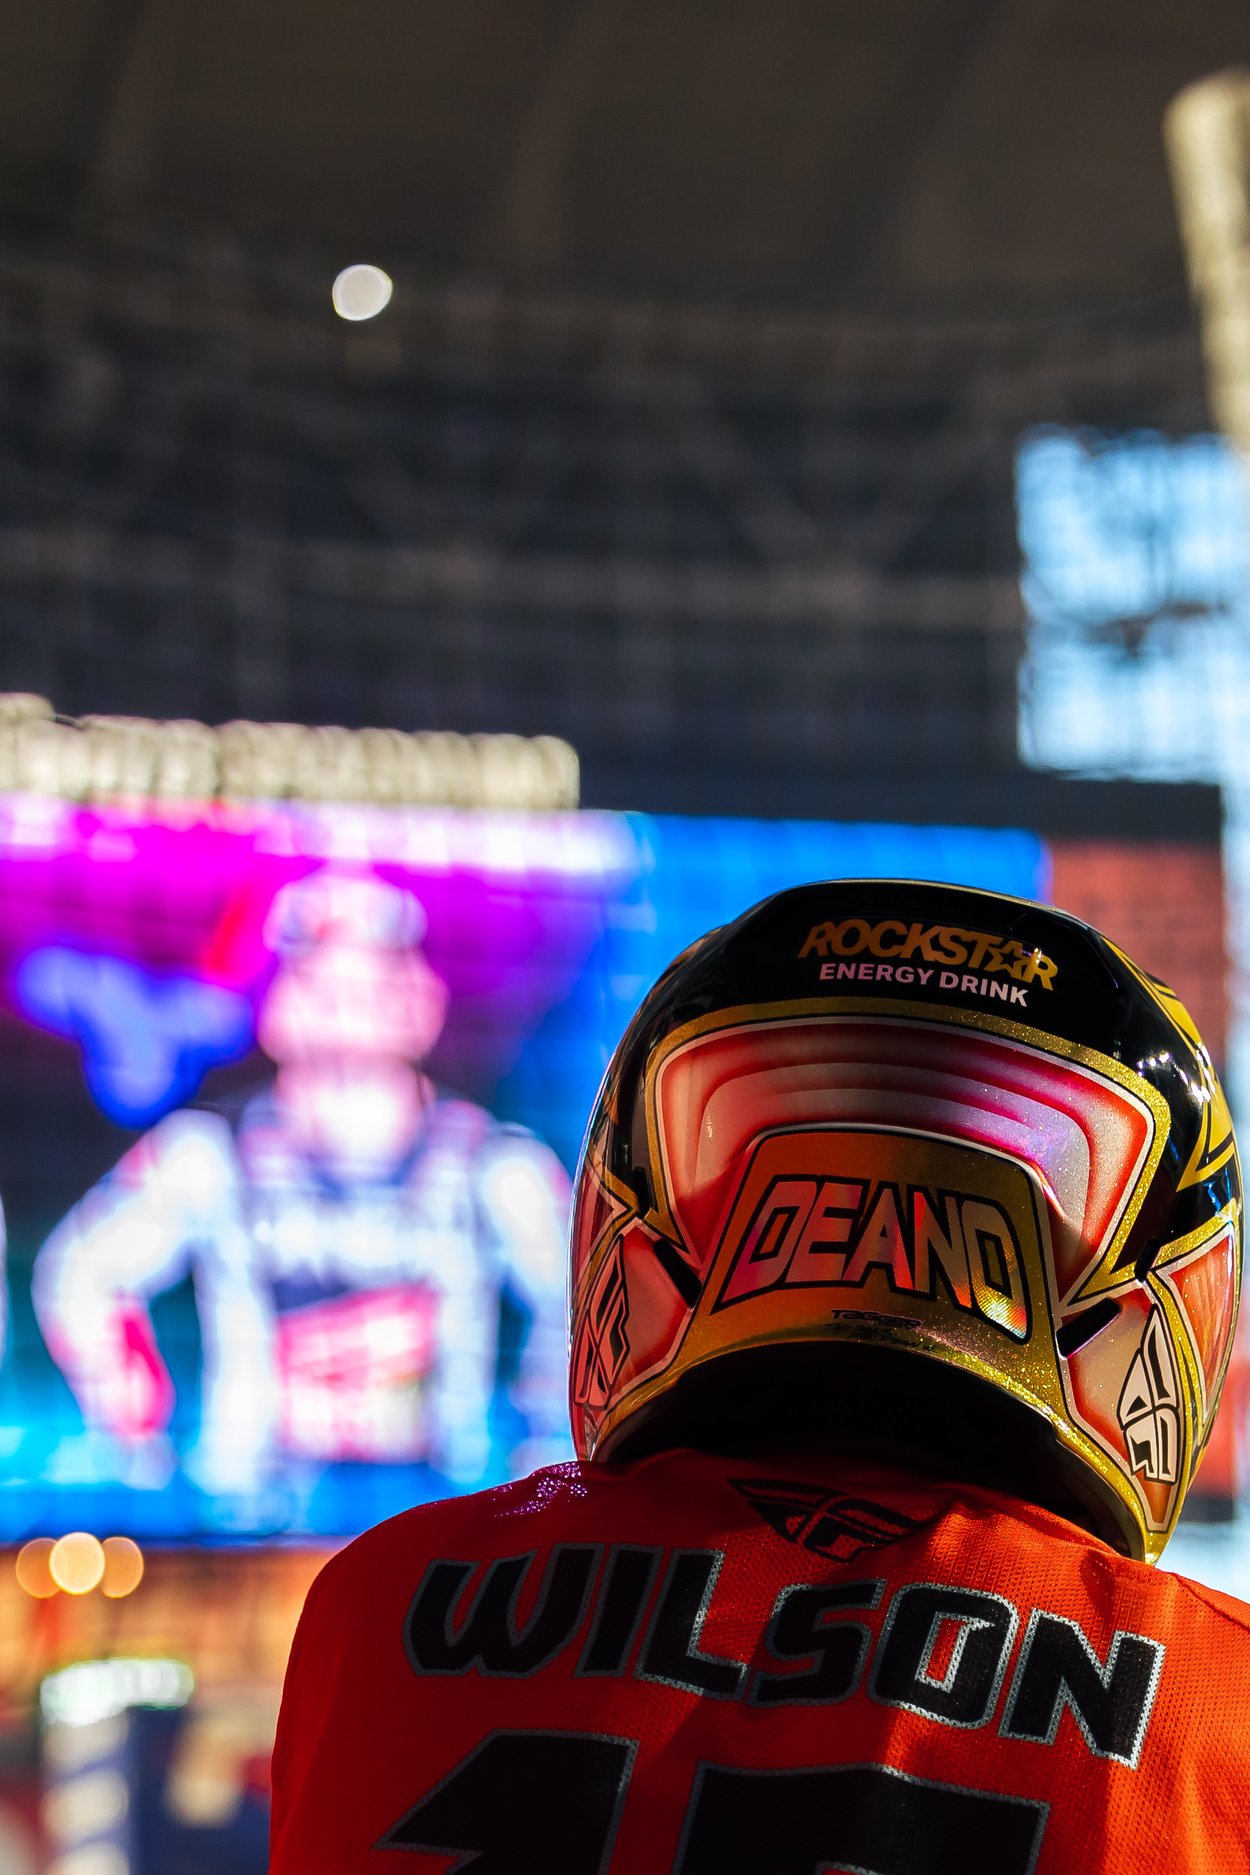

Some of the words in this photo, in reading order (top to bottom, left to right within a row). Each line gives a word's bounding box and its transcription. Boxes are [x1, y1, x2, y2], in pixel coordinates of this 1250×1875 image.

[797, 919, 1058, 991] ROCKSTAR
[819, 963, 934, 985] ENERGY
[939, 971, 1028, 1007] DRINK
[712, 1174, 1031, 1344] DEANO
[403, 1543, 1166, 1769] WILSON
